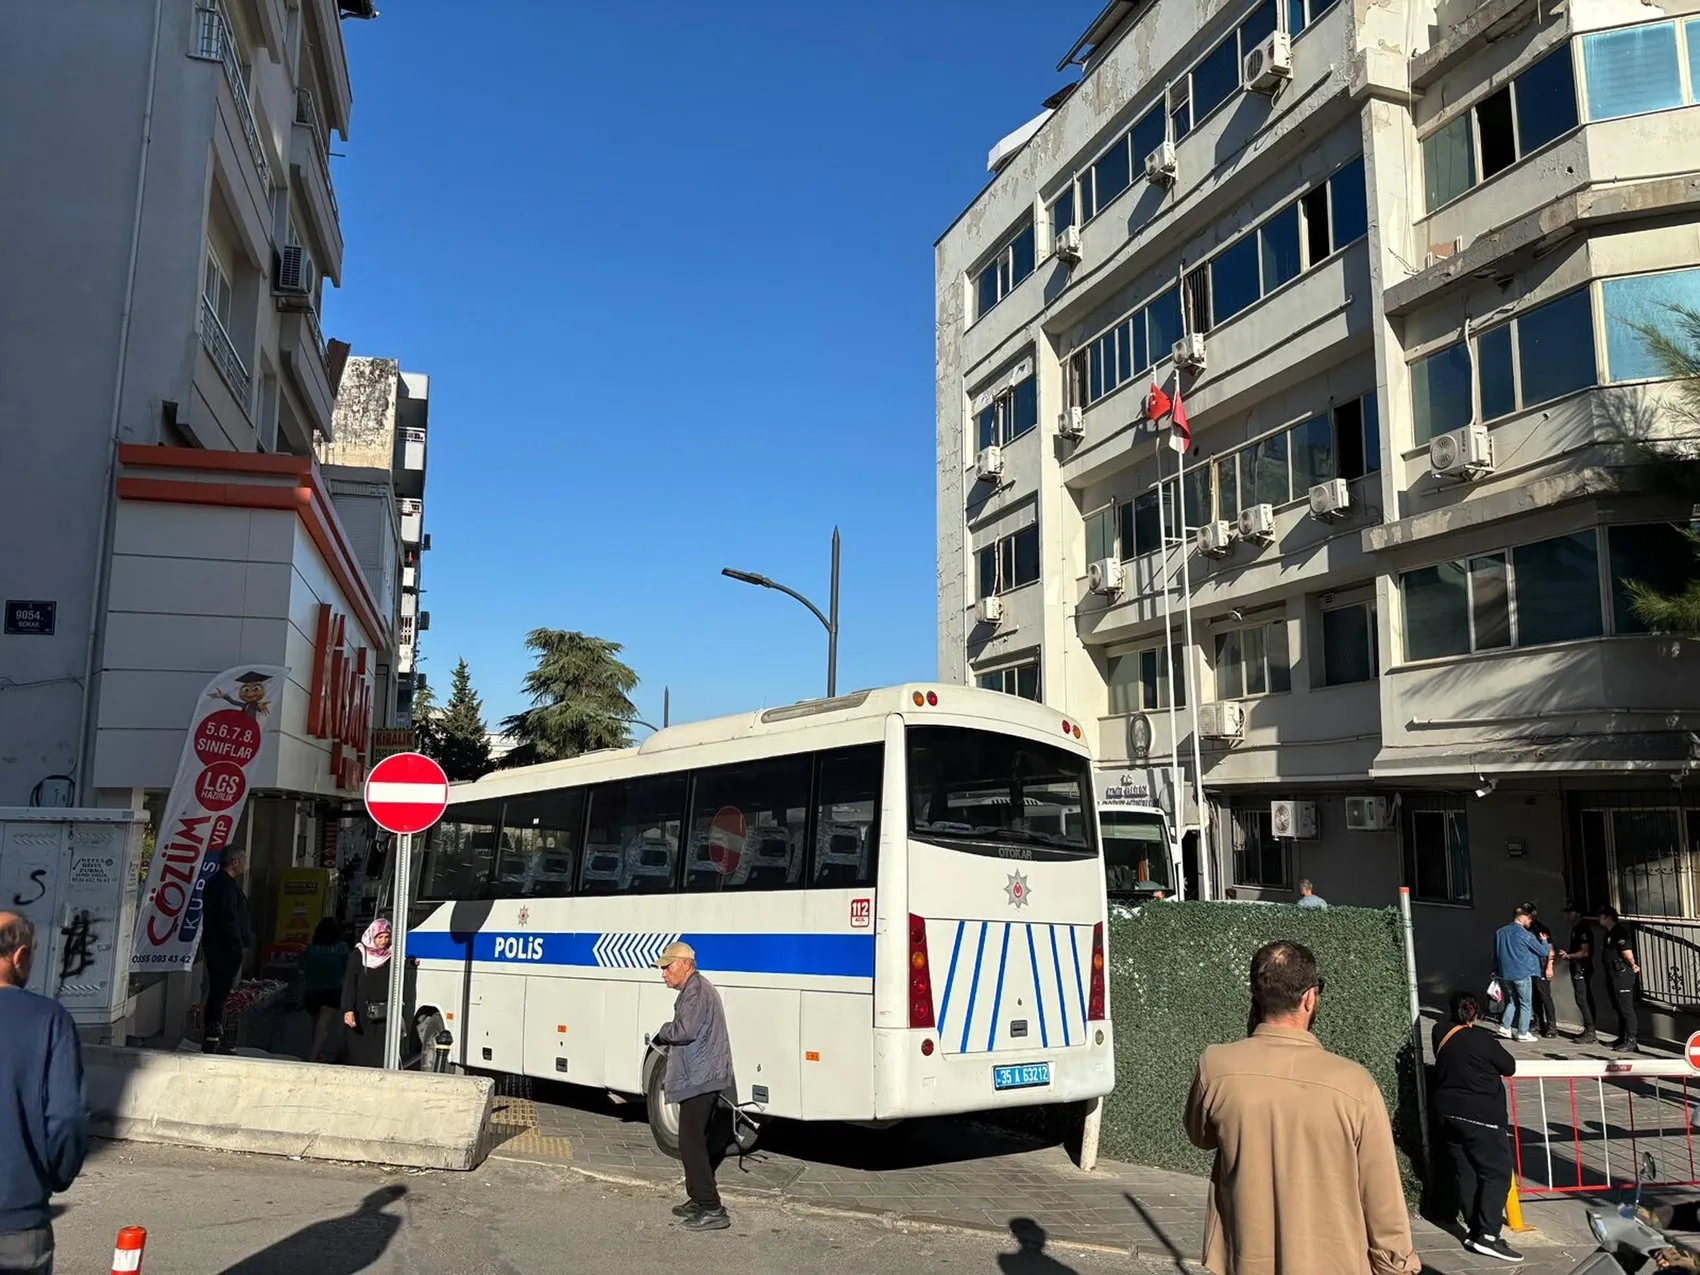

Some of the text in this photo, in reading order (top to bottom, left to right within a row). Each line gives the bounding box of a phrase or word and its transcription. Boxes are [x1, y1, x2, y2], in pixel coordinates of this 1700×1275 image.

[206, 722, 253, 743] 5.6.7.8.
[197, 738, 252, 760] SINIFLAR
[203, 771, 239, 794] LGS
[201, 789, 235, 802] HAZIRLIK
[211, 820, 229, 846] VIP
[998, 848, 1032, 860] OTOKAR
[146, 815, 212, 947] ÇÖZÜM
[852, 902, 868, 916] 112
[1000, 1069, 1012, 1084] 35
[1023, 1066, 1048, 1081] 63212
